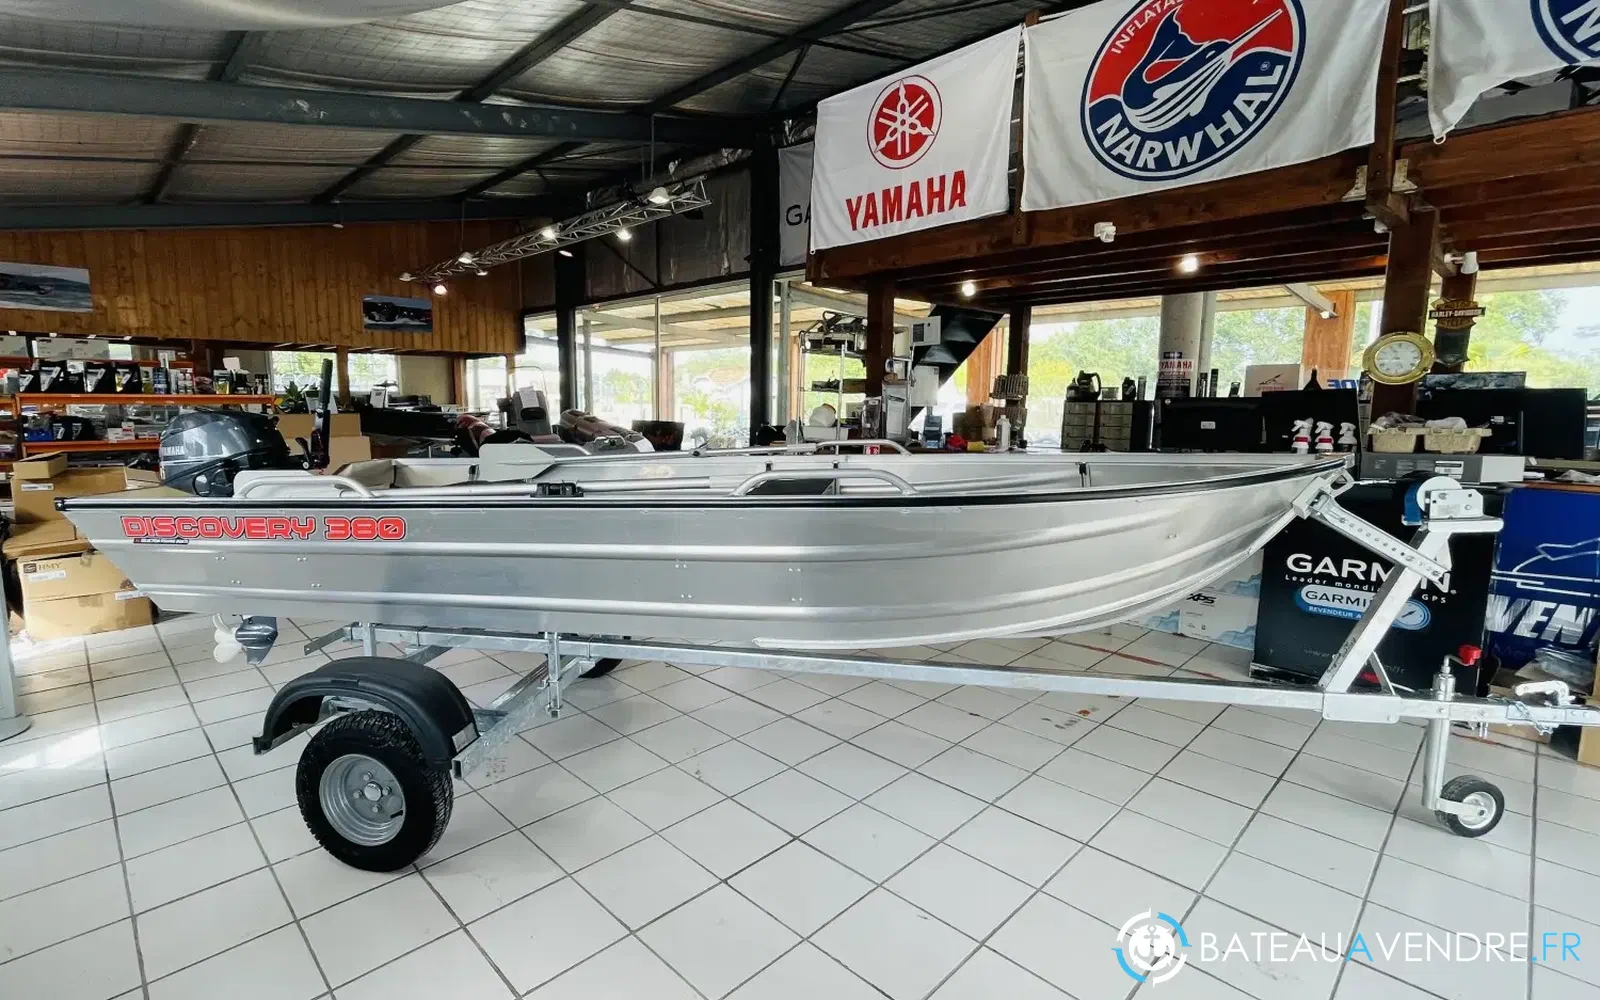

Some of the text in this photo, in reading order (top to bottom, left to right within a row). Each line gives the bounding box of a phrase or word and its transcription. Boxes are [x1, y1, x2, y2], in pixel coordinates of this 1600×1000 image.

[1110, 0, 1184, 54] INFLATA
[1096, 64, 1284, 169] NARWHAL
[845, 170, 966, 231] YAMAHA
[120, 515, 406, 540] DISCOVERY 380
[1285, 574, 1446, 604] Leader mondi GPS
[1286, 553, 1450, 593] GARMN
[1305, 590, 1368, 607] GARMI
[1308, 606, 1354, 618] REVENDEUR
